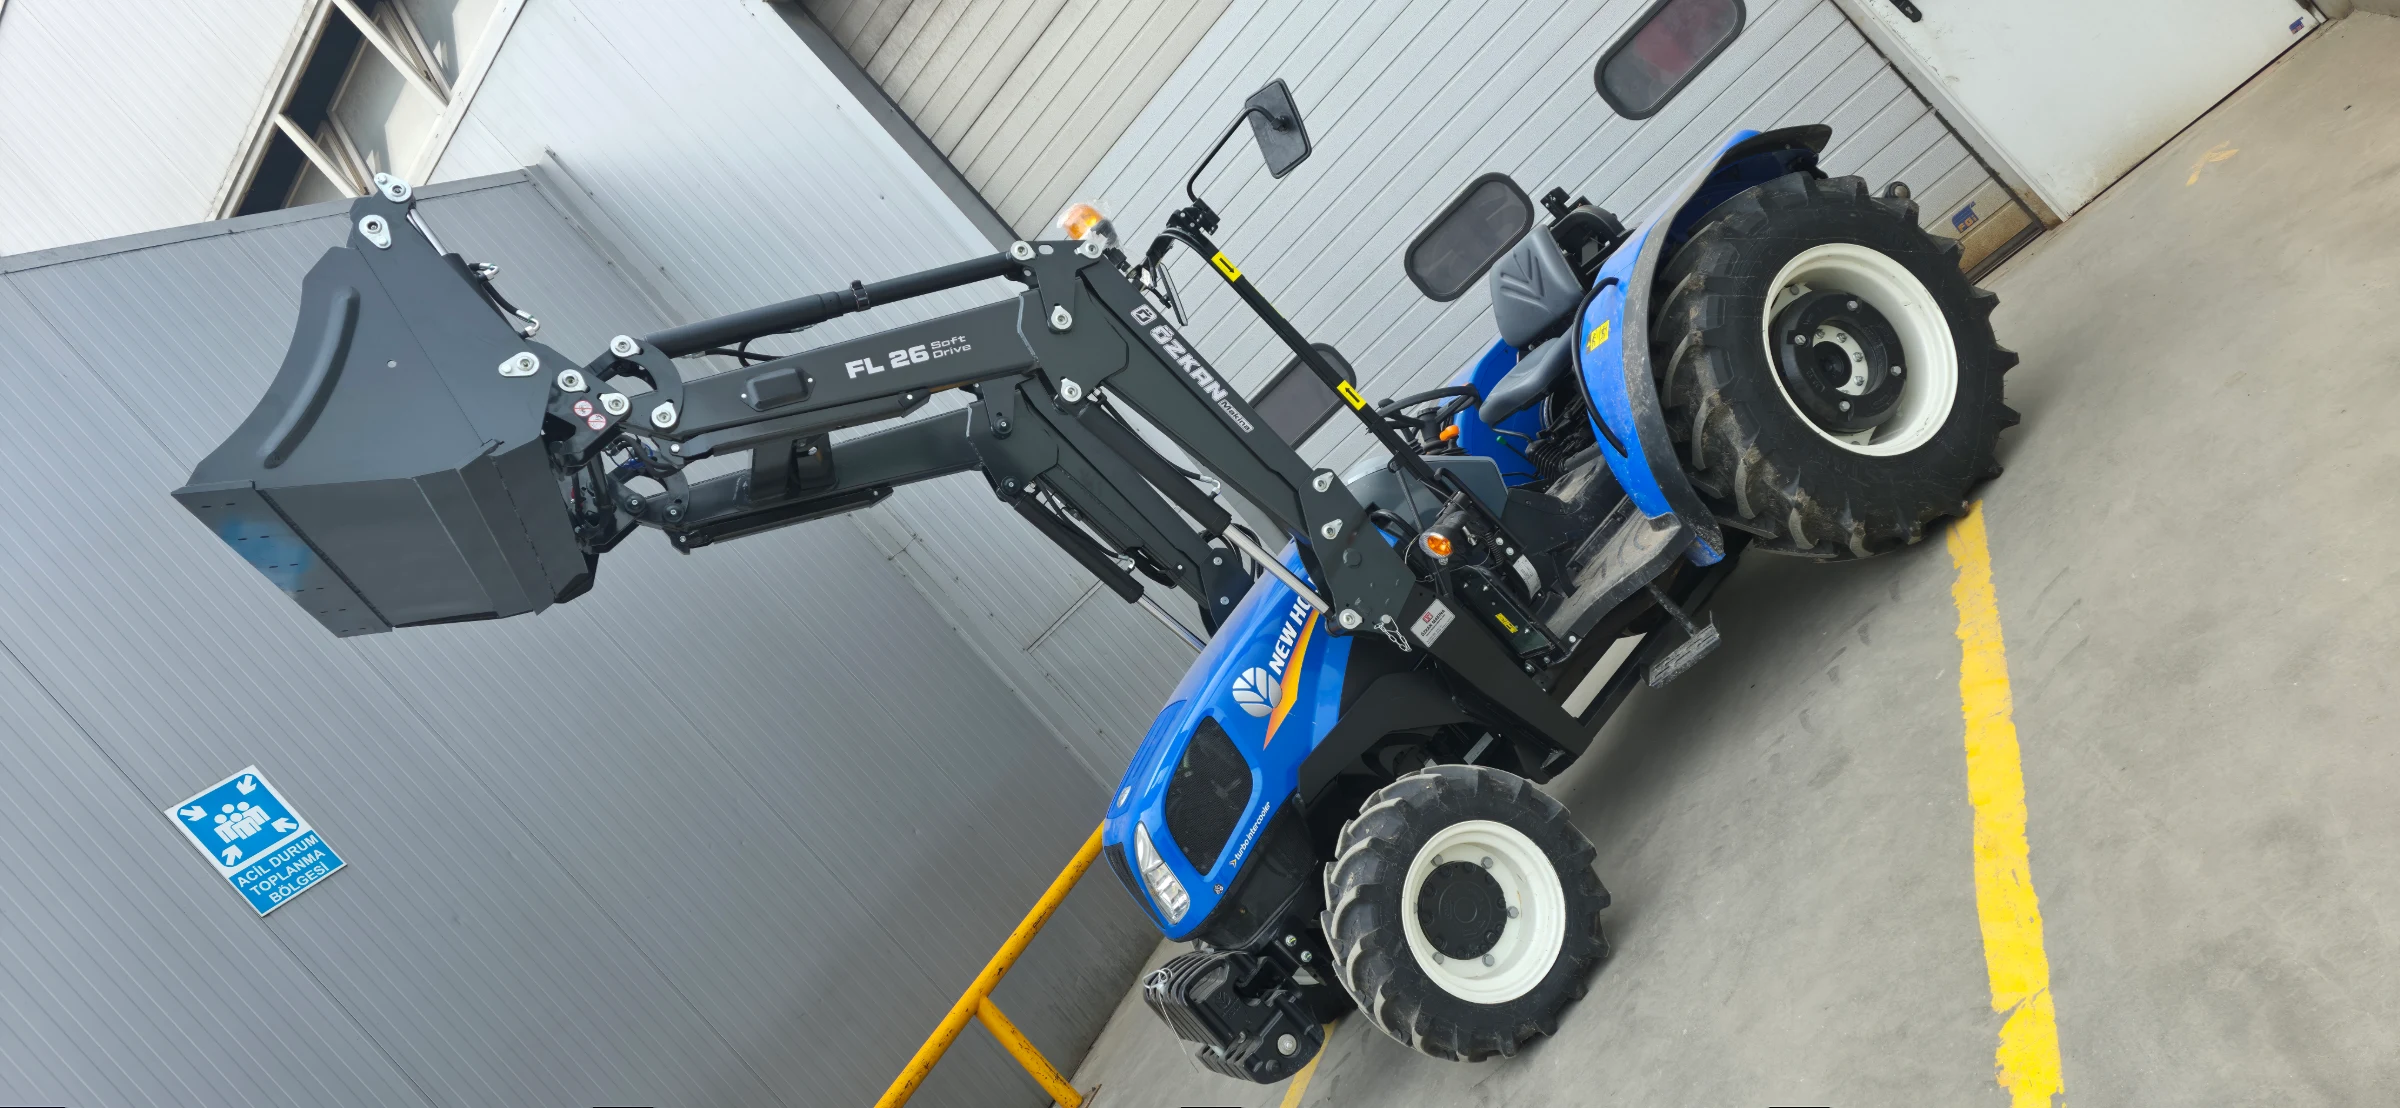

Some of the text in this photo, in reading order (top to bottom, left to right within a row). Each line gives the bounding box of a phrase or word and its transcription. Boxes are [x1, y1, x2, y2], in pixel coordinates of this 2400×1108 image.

[845, 344, 930, 379] FL 26
[931, 335, 967, 350] Soft
[933, 344, 972, 359] Drive
[1150, 325, 1228, 402] ÖZKAN
[1221, 400, 1252, 431] Makina
[1268, 620, 1298, 676] NEW
[1234, 801, 1270, 860] turbo intercooler
[237, 834, 319, 888] ACİL DURUM
[249, 849, 326, 896] TOPLANMA
[268, 861, 330, 904] BÖLGESİ
